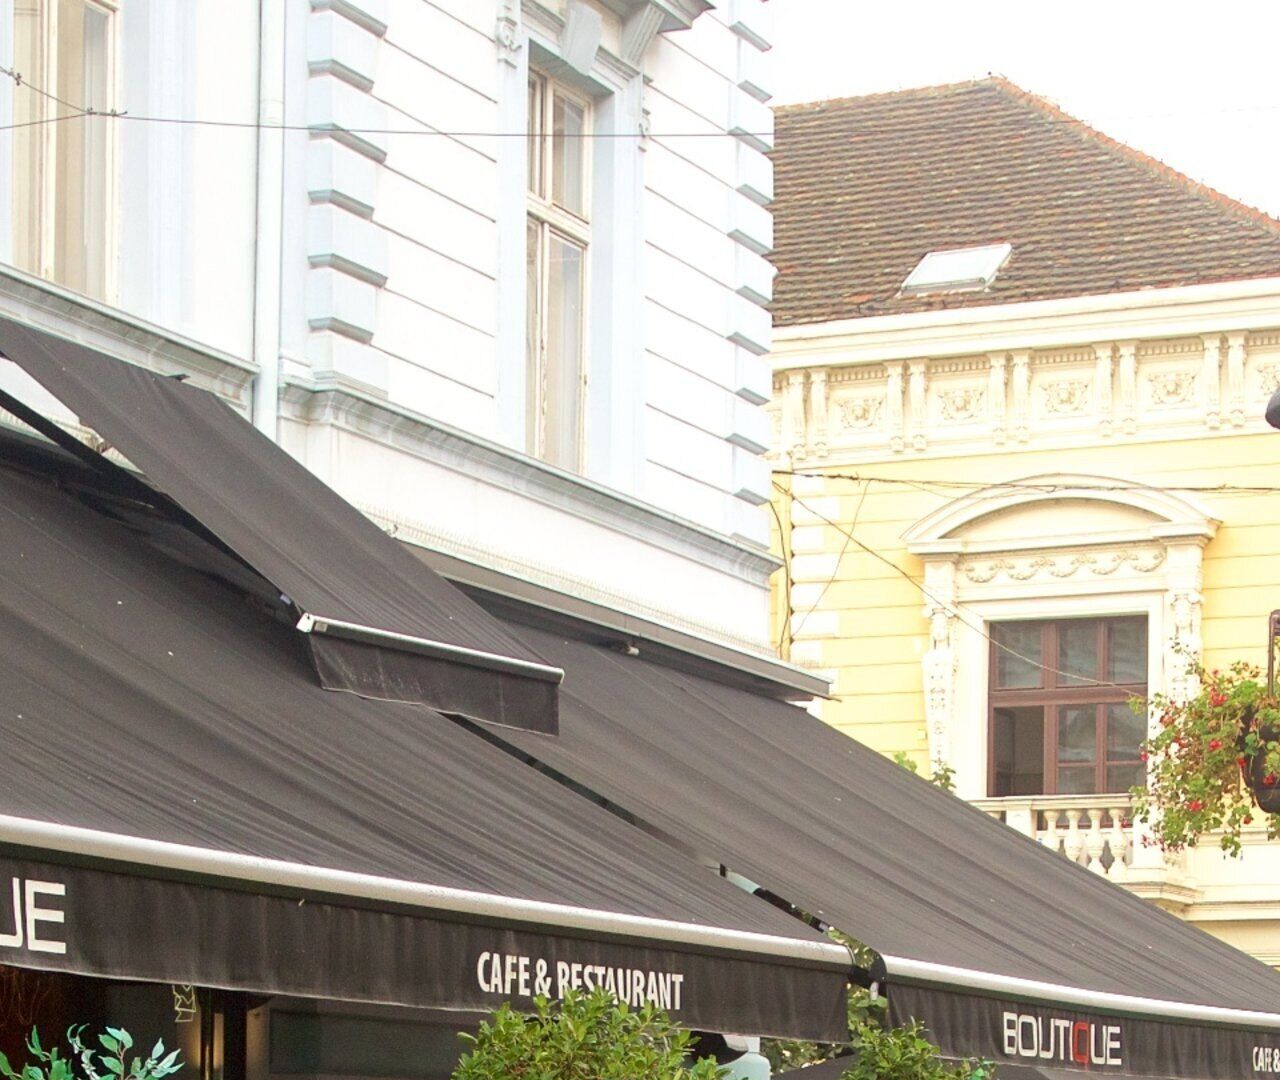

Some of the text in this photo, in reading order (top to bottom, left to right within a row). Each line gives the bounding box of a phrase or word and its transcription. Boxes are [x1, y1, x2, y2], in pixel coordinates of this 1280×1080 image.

[477, 951, 683, 1010] CAFE & RESTAURANT
[1003, 1012, 1122, 1071] BOUTIQUE
[1253, 1046, 1273, 1073] CAFE
